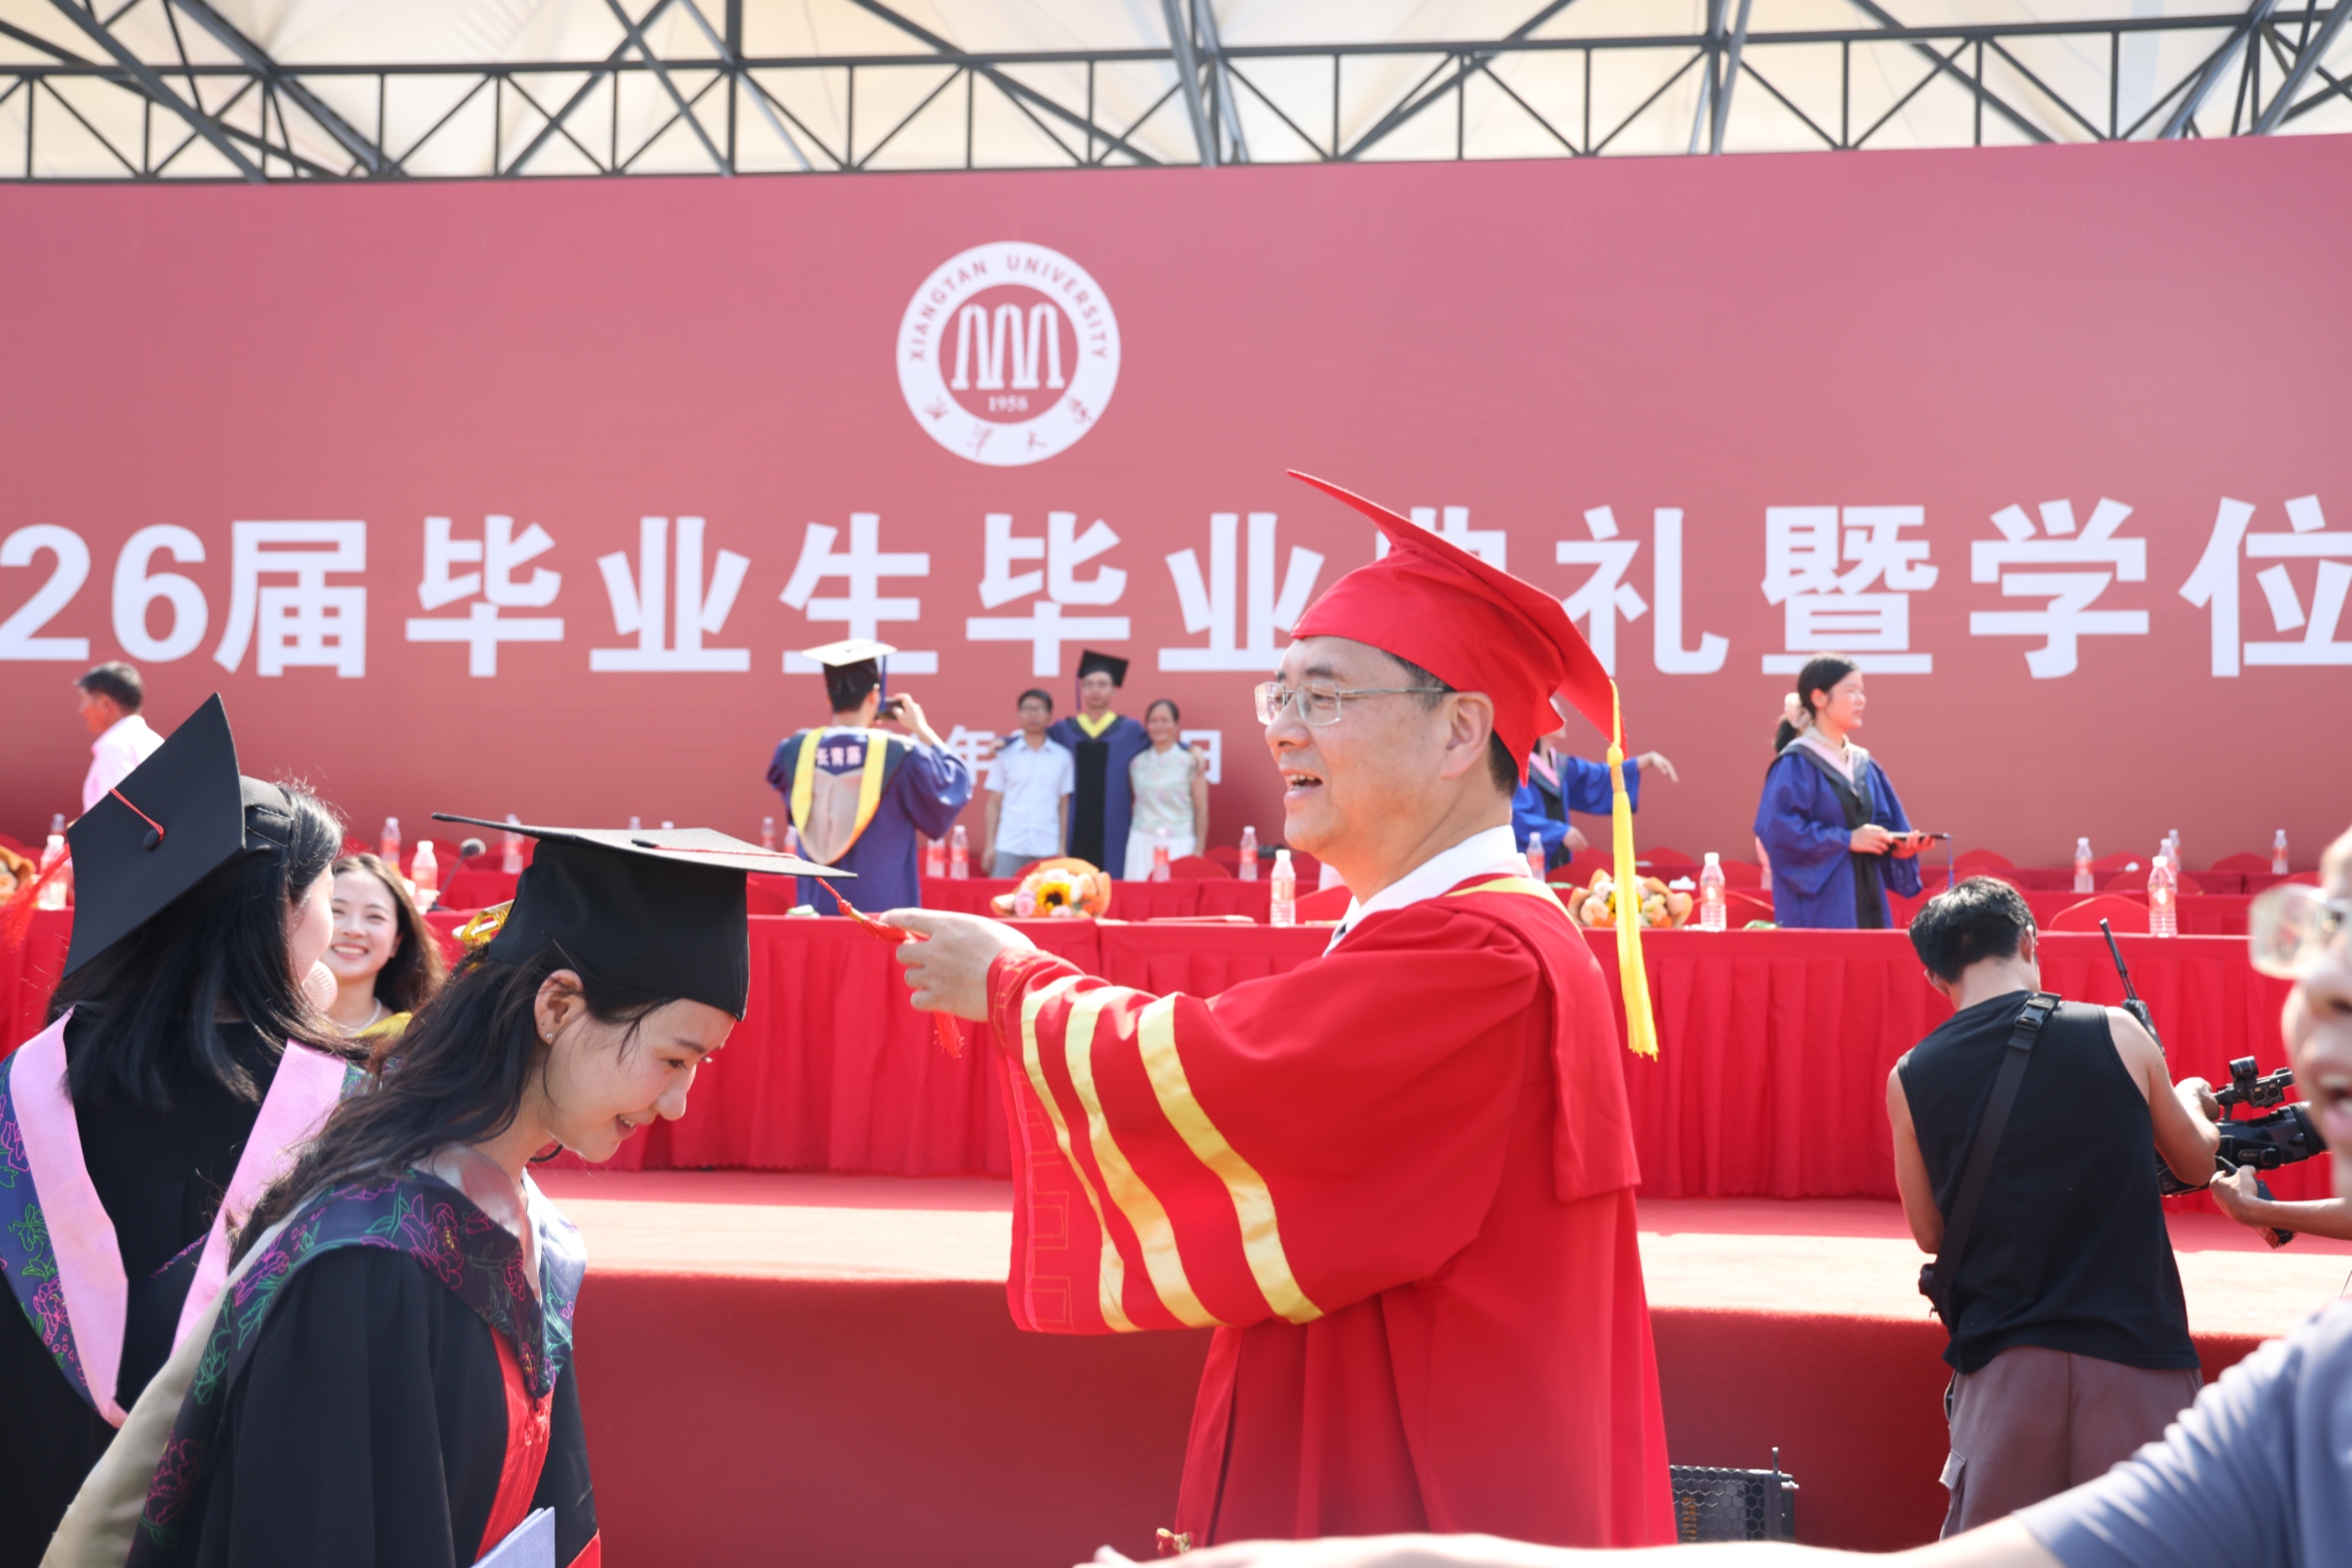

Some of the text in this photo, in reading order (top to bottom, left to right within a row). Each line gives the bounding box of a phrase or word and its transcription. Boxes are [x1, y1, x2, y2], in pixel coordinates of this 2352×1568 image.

[909, 253, 1108, 362] XIANGTAN UNIVERSITY
[988, 395, 1029, 413] 1958
[0, 493, 2352, 678] 26届毕业生毕业礼暨学位
